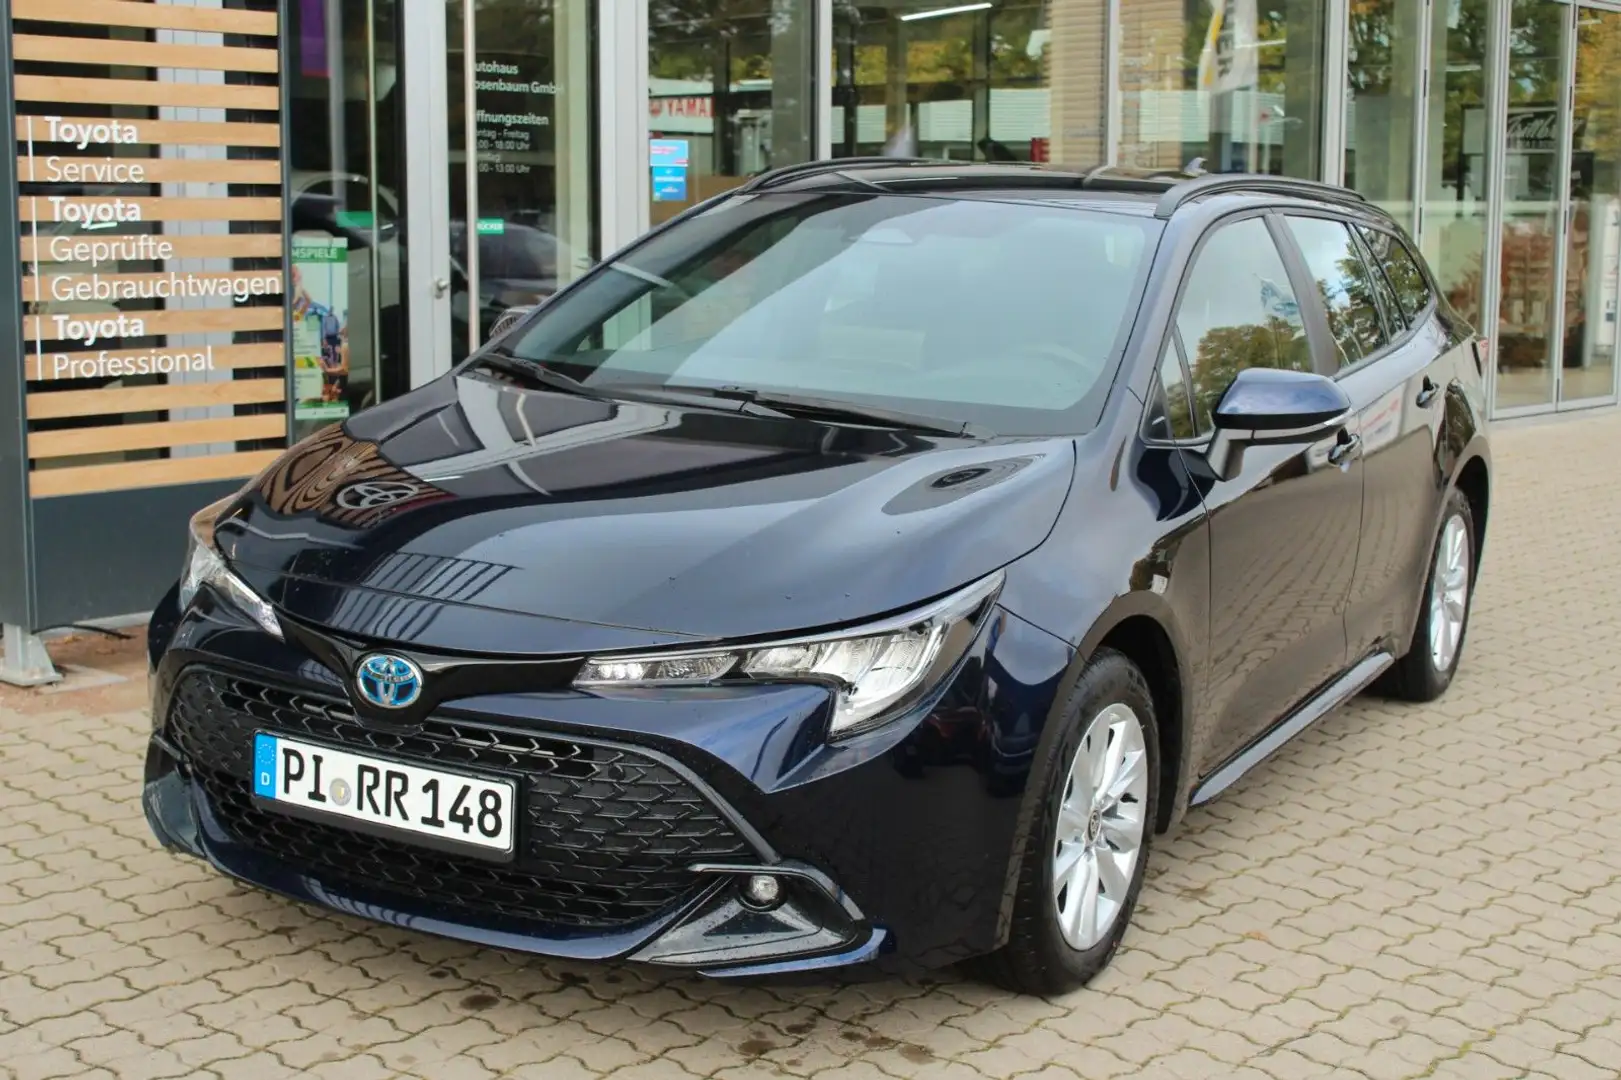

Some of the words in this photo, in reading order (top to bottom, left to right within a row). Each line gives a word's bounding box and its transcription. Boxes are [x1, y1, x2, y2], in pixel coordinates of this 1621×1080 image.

[476, 61, 518, 75] utohaus
[475, 78, 530, 93] osenbaum
[45, 115, 138, 149] Toyota
[477, 109, 549, 127] ffnungszeiten
[46, 156, 145, 183] Service
[48, 196, 141, 229] Toyota
[50, 234, 173, 267] Geprüfte
[292, 247, 338, 259] MSPIELE
[51, 272, 280, 303] Gebrauchtwagen
[53, 315, 145, 346] Toyota
[54, 345, 215, 379] Professional
[260, 771, 271, 786] D
[282, 747, 327, 803] PI
[357, 764, 410, 821] RR
[421, 778, 502, 838] 148
